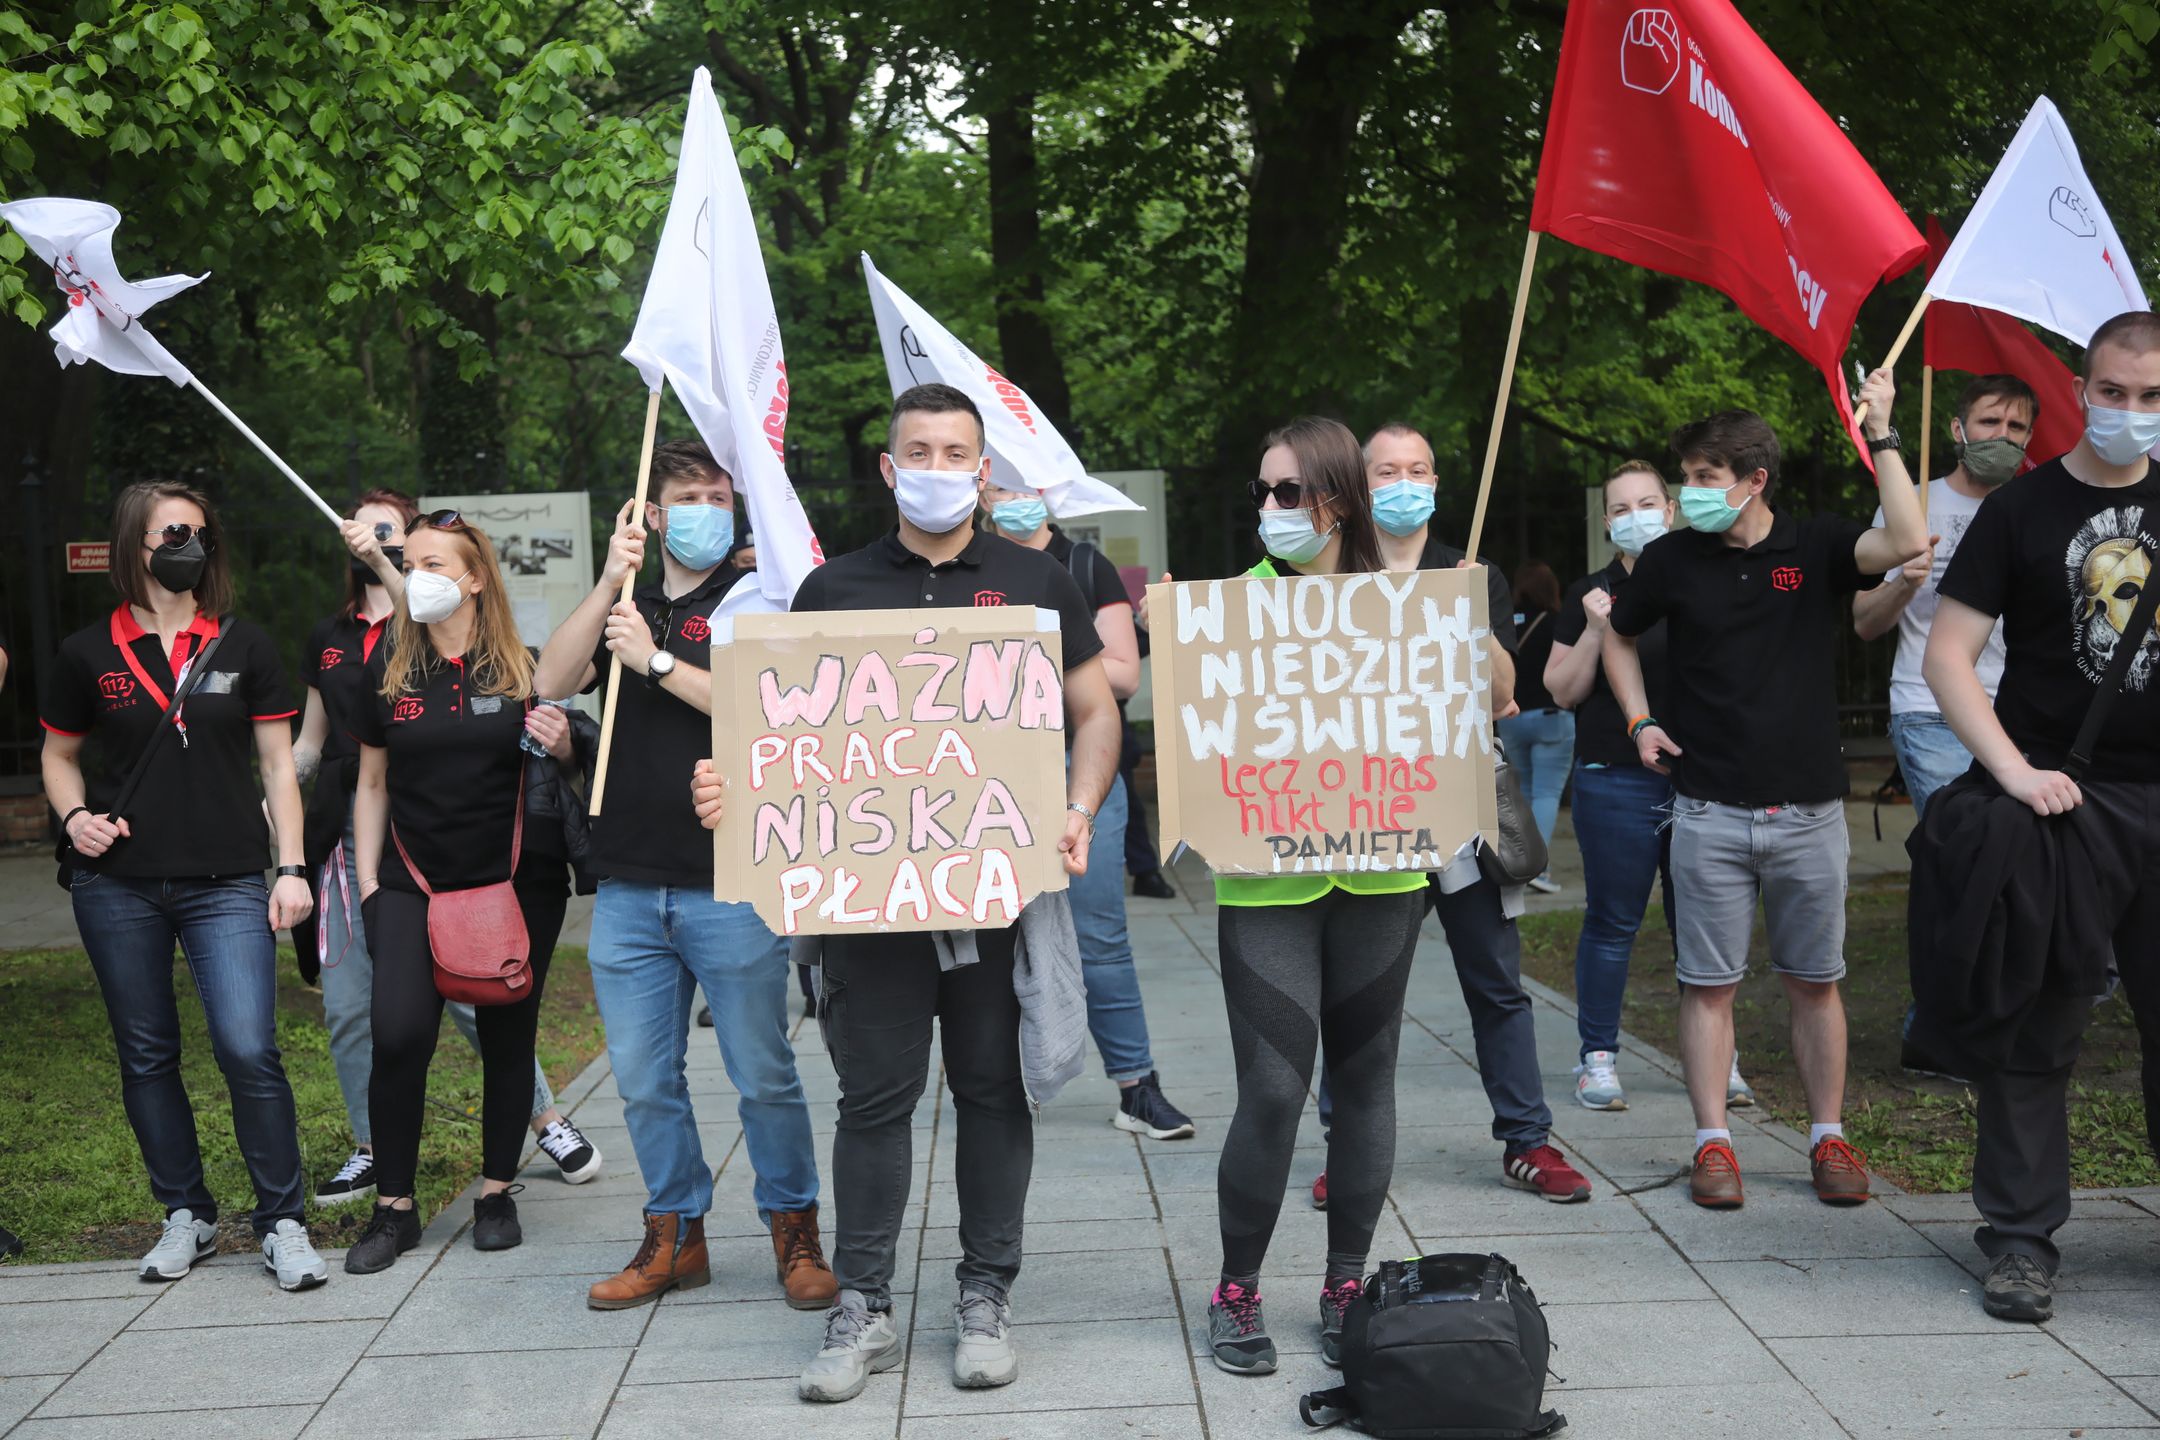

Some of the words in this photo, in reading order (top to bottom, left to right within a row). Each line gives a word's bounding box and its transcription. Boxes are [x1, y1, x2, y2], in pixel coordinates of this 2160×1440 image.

[1776, 572, 1797, 585] 112
[688, 622, 707, 634] 112
[1176, 581, 1225, 643] W
[1246, 572, 1419, 641] NOCY
[103, 677, 128, 693] 112
[758, 627, 1064, 731] WAŻNA
[398, 702, 417, 714] 112
[1180, 698, 1238, 761] W
[1253, 688, 1492, 763] ŚWIĘTA
[749, 727, 979, 792] PRACA
[1318, 758, 1346, 791] o
[1362, 753, 1438, 793] nas
[1239, 791, 1329, 836] nikt
[1349, 790, 1417, 832] nie
[778, 848, 1022, 935] PŁACA
